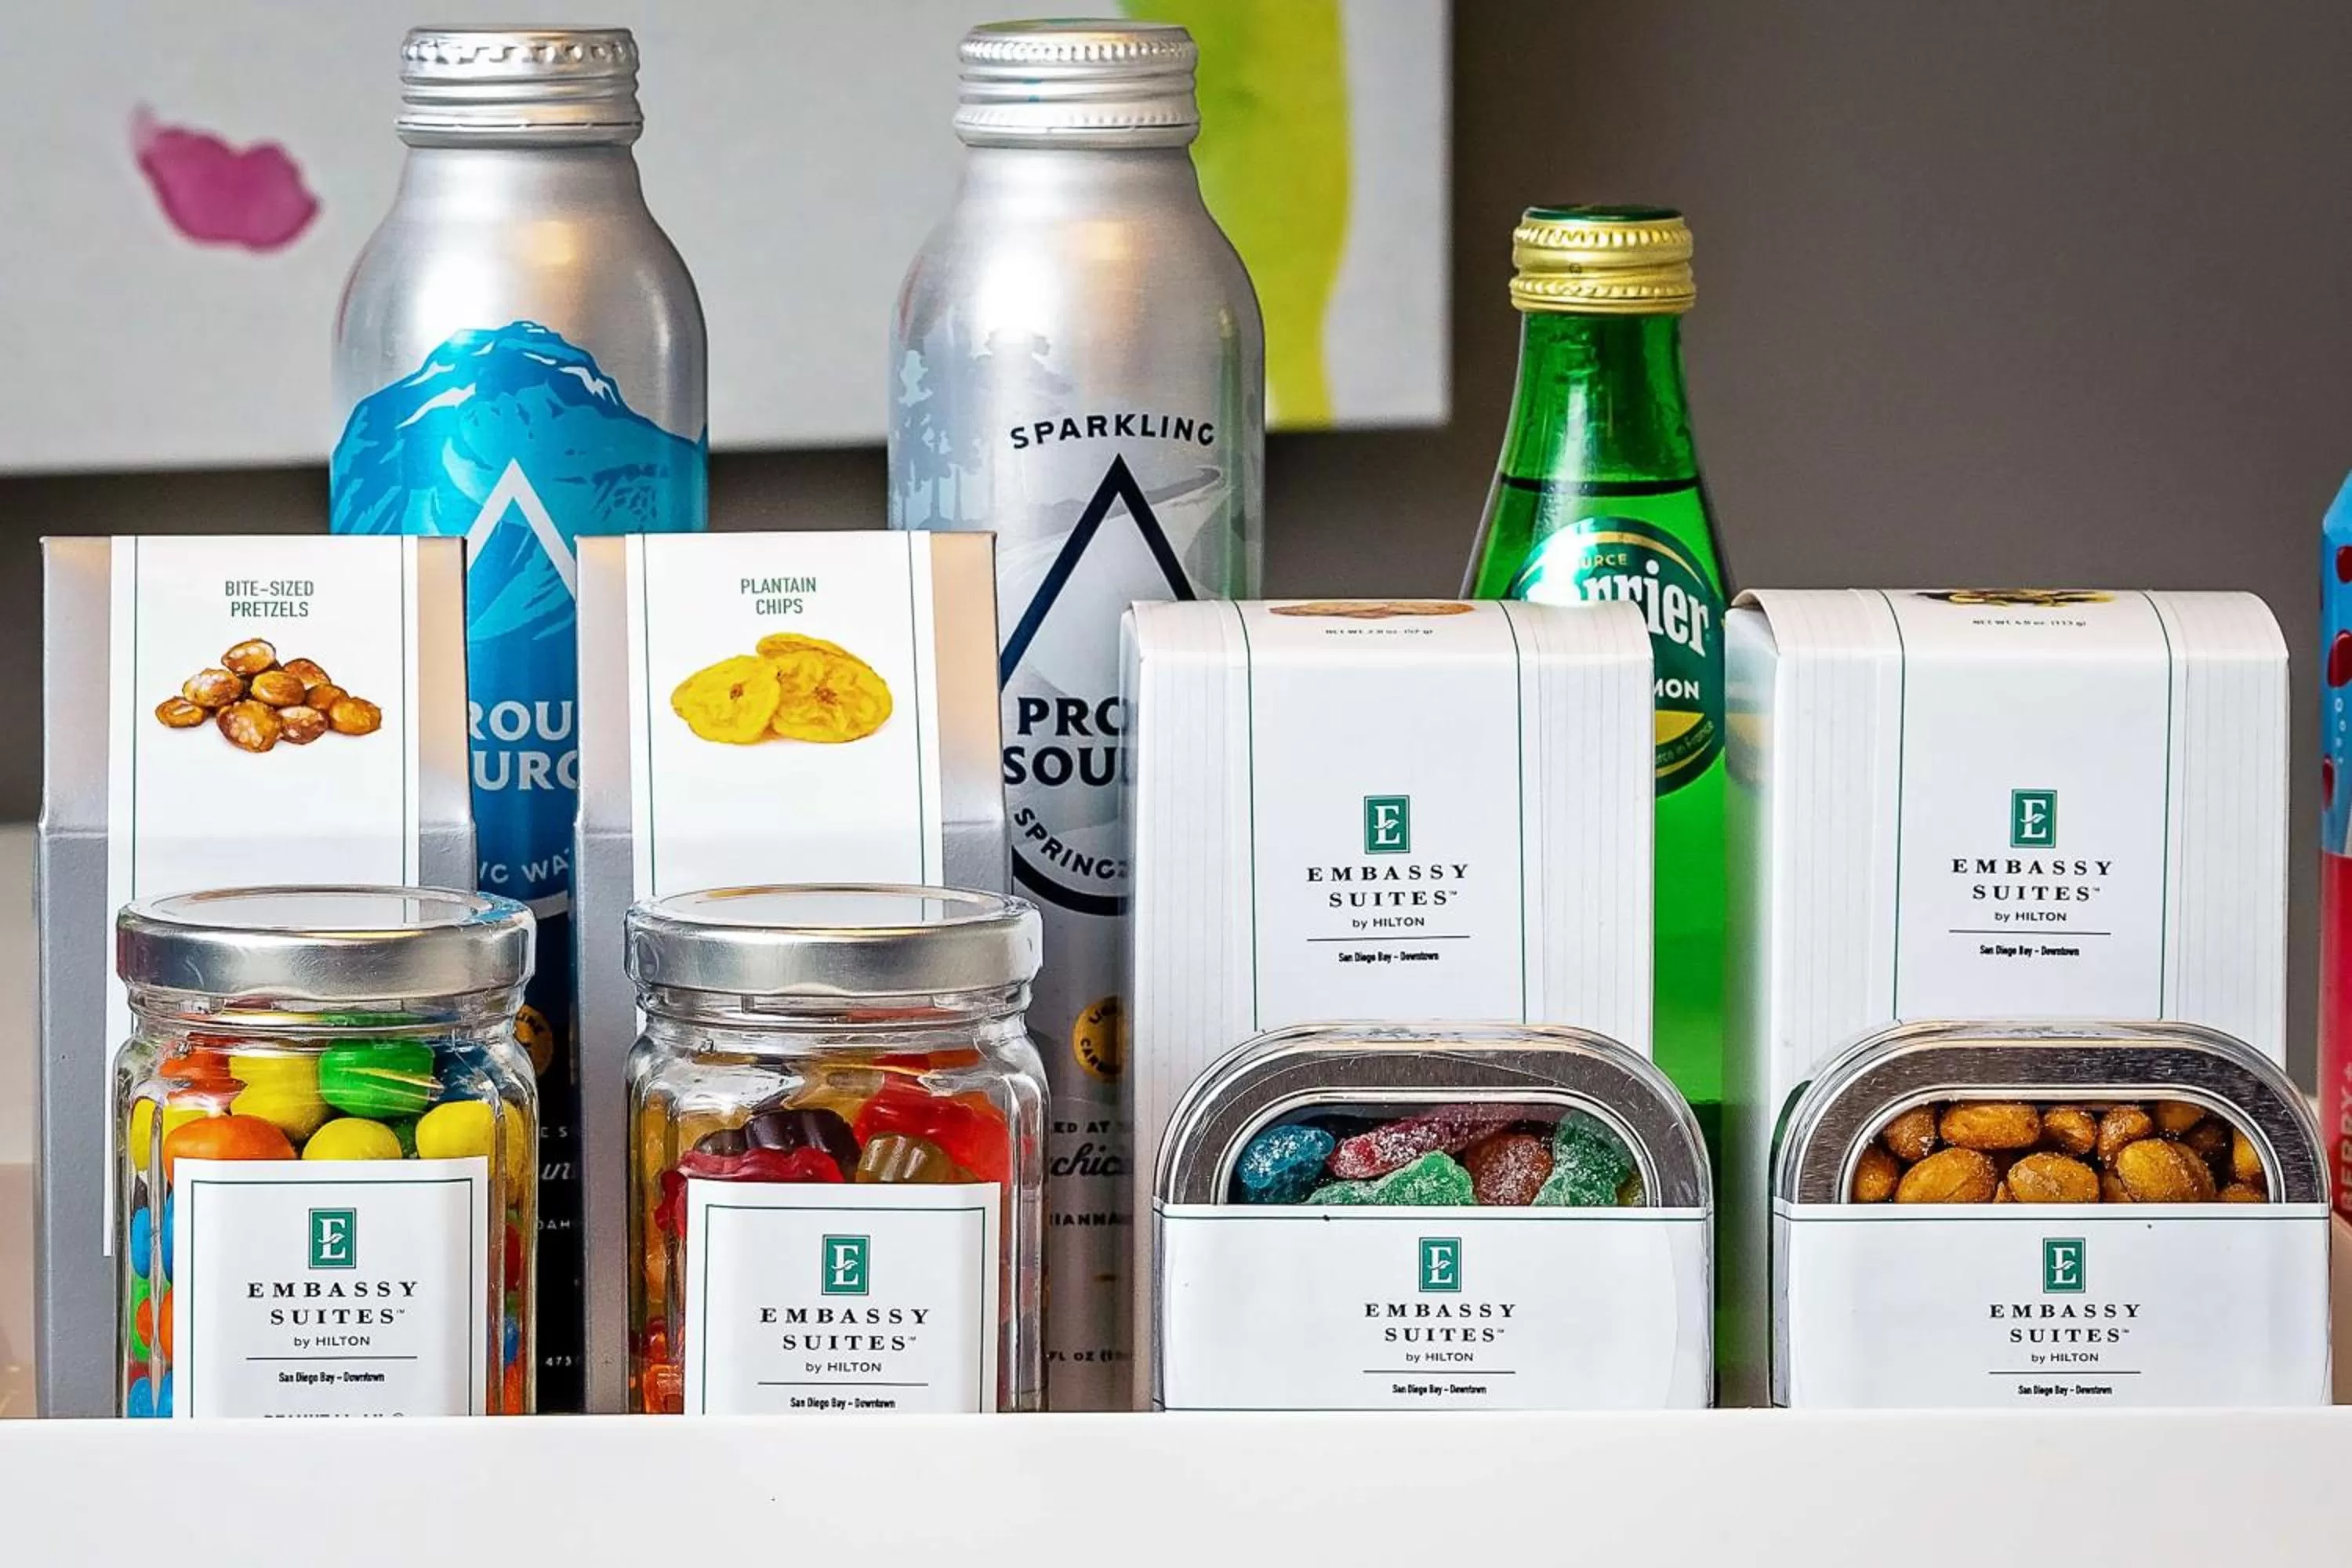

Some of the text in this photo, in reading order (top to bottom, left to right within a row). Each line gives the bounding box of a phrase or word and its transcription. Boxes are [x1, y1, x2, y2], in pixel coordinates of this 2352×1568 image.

[1010, 413, 1215, 449] SPARKLING
[225, 580, 314, 597] BITE-SIZED
[741, 578, 817, 593] PLANTAIN
[231, 601, 309, 618] PRETZELS
[756, 599, 803, 615] CHIPS
[468, 700, 573, 741] ROU
[1017, 696, 1128, 736] PRO
[1004, 746, 1129, 785] SOU
[1307, 864, 1468, 882] EMBASSY
[1952, 858, 2112, 876] EMBASSY
[1352, 917, 1425, 930] by HILTON
[1994, 912, 2067, 923] by HILTON
[1338, 951, 1353, 962] San
[1354, 951, 1377, 964] Diego
[1377, 951, 1392, 964] Bay
[1399, 951, 1440, 962] Downtown
[1980, 945, 1994, 956] San
[1995, 945, 2017, 957] Diego
[2019, 945, 2033, 957] Bay
[2041, 945, 2080, 956] Downtown
[248, 1280, 417, 1298] EMBASSY
[760, 1307, 929, 1324] EMBASSY
[1365, 1303, 1516, 1318] EMBASSY
[1990, 1304, 2141, 1319] EMBASSY
[294, 1336, 370, 1349] by HILTON
[1406, 1353, 1474, 1364] by HILTON
[2031, 1353, 2099, 1365] by HILTON
[805, 1362, 882, 1374] by HILTON
[278, 1372, 294, 1382] San
[296, 1372, 319, 1385] Diego
[320, 1372, 335, 1385] Bay
[343, 1372, 385, 1382] Downtown
[1392, 1385, 1406, 1393] San
[1407, 1385, 1428, 1396] Diego
[1429, 1385, 1443, 1396] Bay
[1450, 1385, 1487, 1393] Downtown
[2018, 1385, 2032, 1395] San
[2033, 1385, 2053, 1397] Diego
[2055, 1385, 2068, 1397] Bay
[2075, 1385, 2113, 1395] Downtown
[790, 1397, 806, 1408] San
[807, 1397, 829, 1410] Diego
[831, 1397, 847, 1410] Bay
[855, 1397, 896, 1408] Downtown
